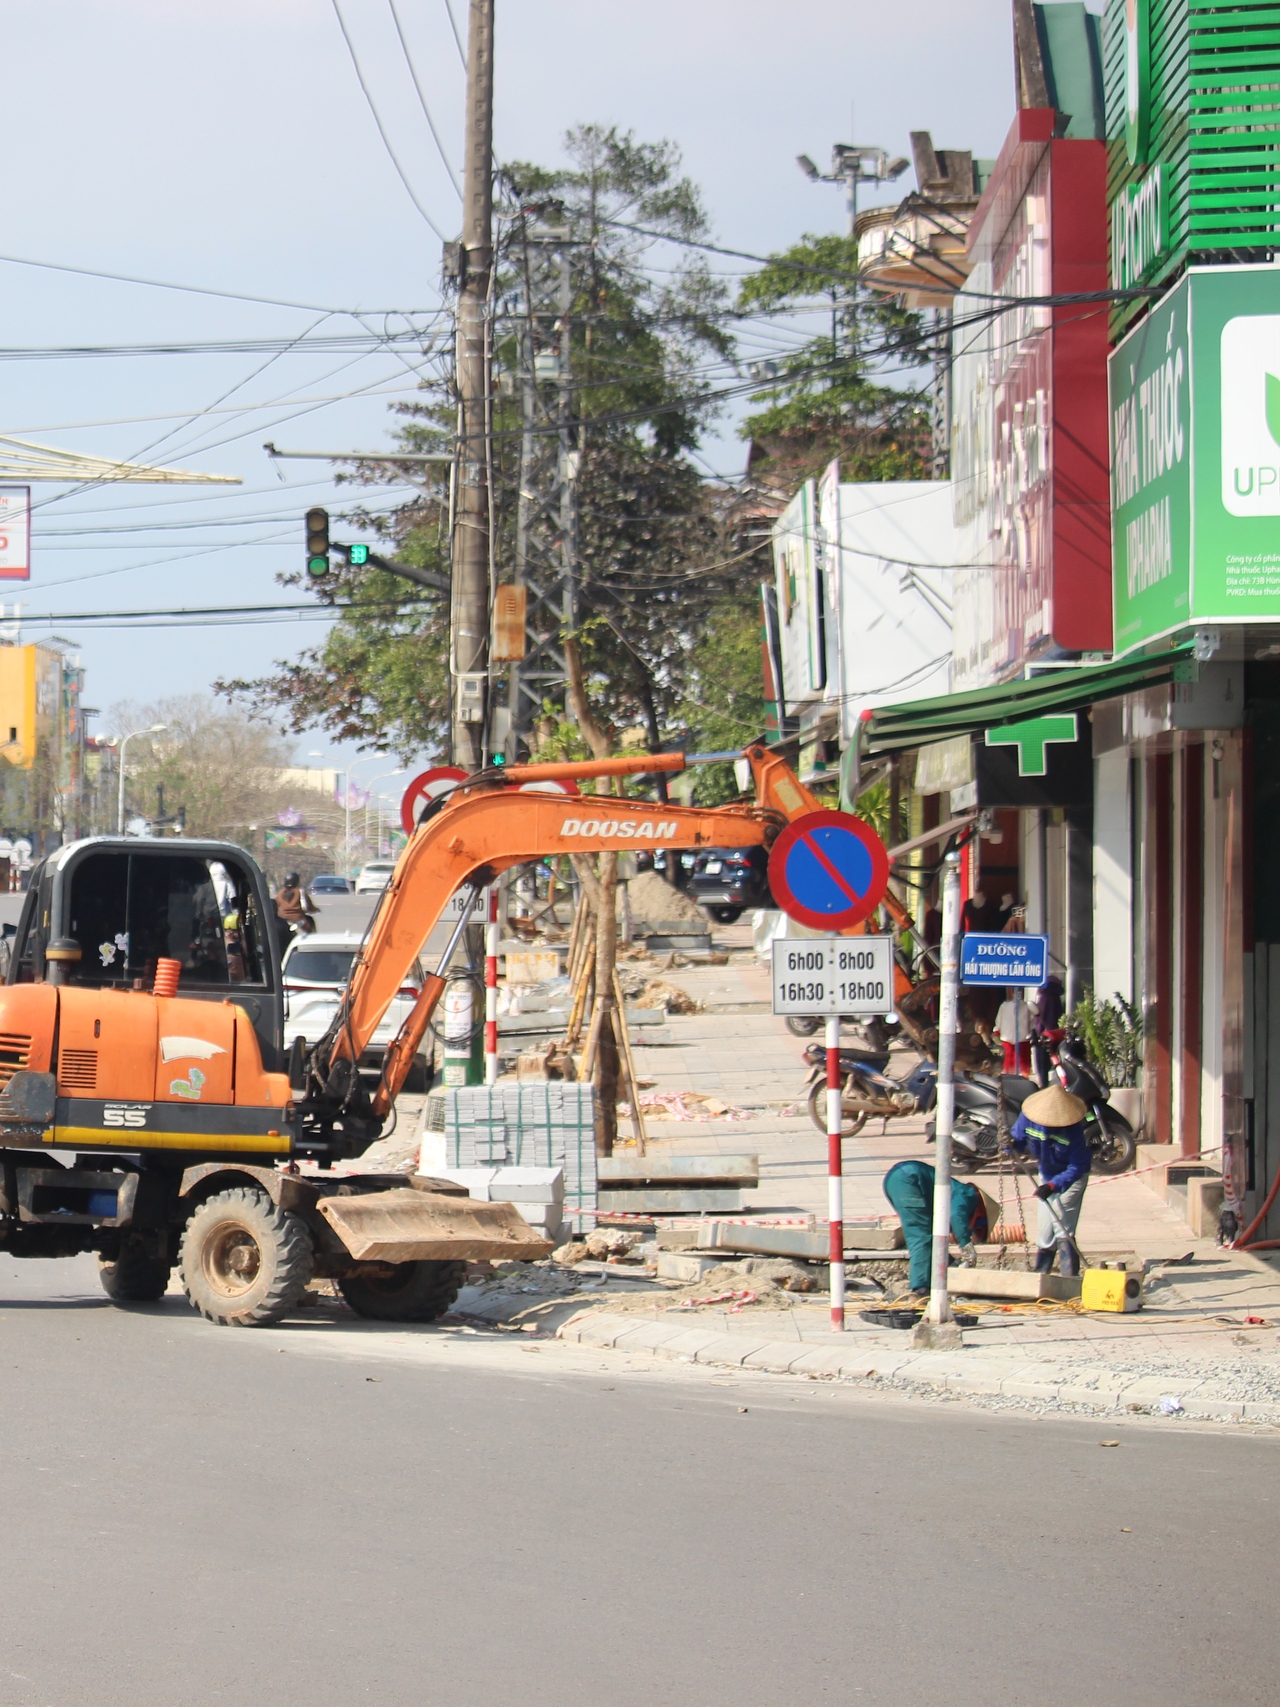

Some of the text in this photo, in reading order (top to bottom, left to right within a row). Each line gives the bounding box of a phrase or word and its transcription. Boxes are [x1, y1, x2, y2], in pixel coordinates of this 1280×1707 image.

[1115, 311, 1184, 510] NHÀ THUỐC
[1234, 467, 1280, 496] UP
[1126, 495, 1172, 600] UPHARMA
[1226, 554, 1244, 565] Công
[559, 818, 678, 839] DOOSAN
[451, 898, 484, 912] 180
[977, 942, 1027, 957] ĐƯỜNG
[787, 951, 824, 971] 6h00
[838, 951, 875, 970] 8h00
[978, 961, 1008, 979] THƯỢNG
[1009, 960, 1024, 977] LÃN
[1025, 960, 1041, 977] ÔNG
[779, 982, 824, 1001] 16h30
[839, 981, 884, 1000] 18h00
